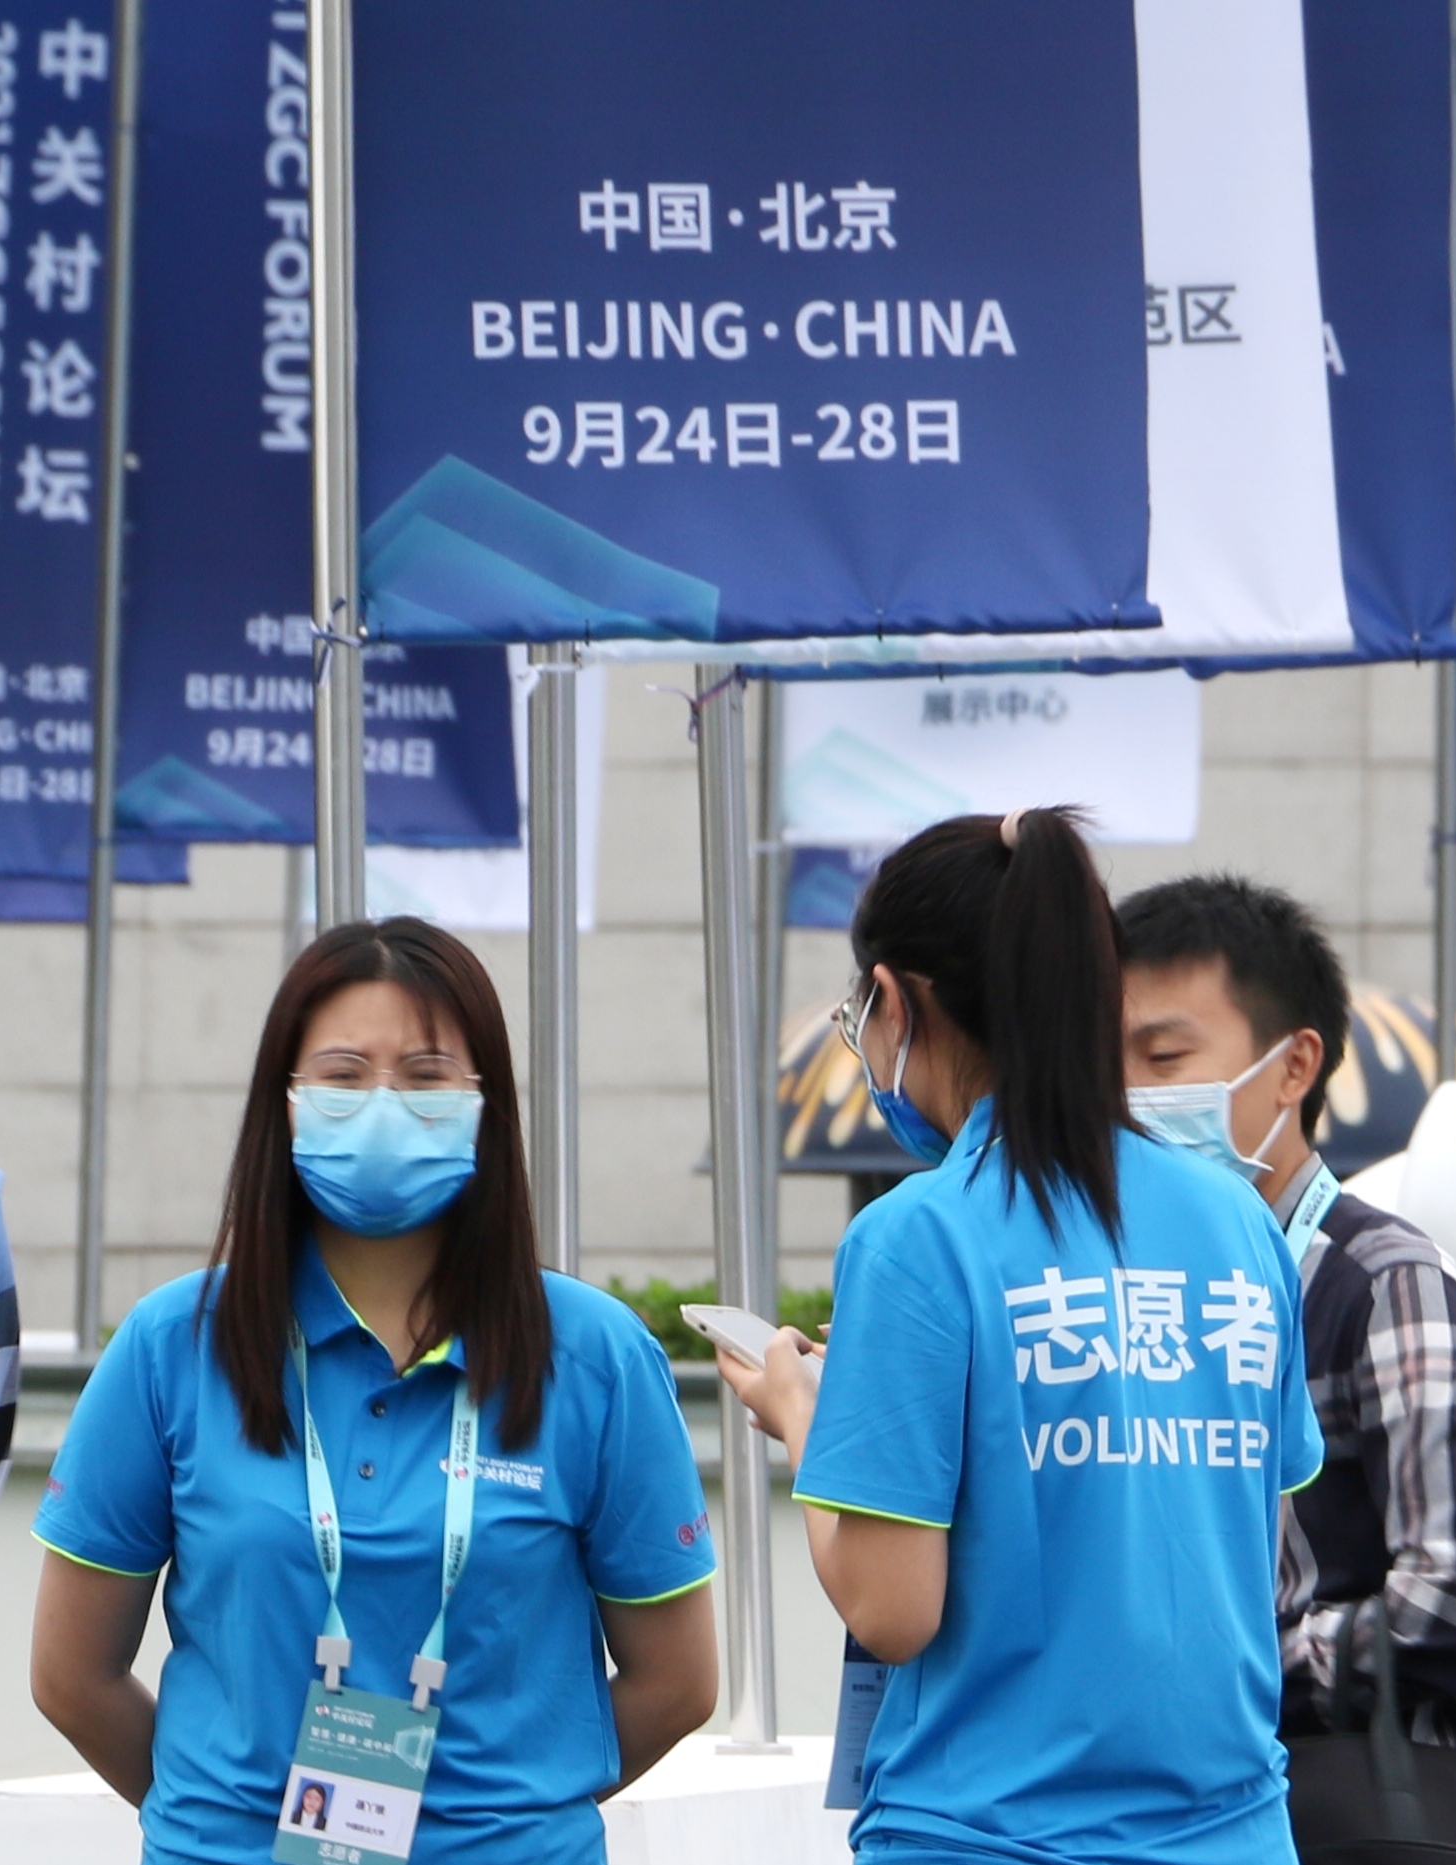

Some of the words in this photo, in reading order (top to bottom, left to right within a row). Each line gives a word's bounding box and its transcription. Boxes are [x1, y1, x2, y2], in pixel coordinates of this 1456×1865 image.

[264, 38, 309, 190] ZGC
[577, 178, 899, 256] 中国·北京
[16, 18, 106, 526] 中关村论坛
[259, 198, 312, 453] FORUM
[471, 298, 1018, 362] BEIJING·CHINA
[522, 399, 963, 470] 9月24日-28日
[921, 686, 1069, 726] 展示中心
[1004, 1266, 1279, 1390] 志愿者
